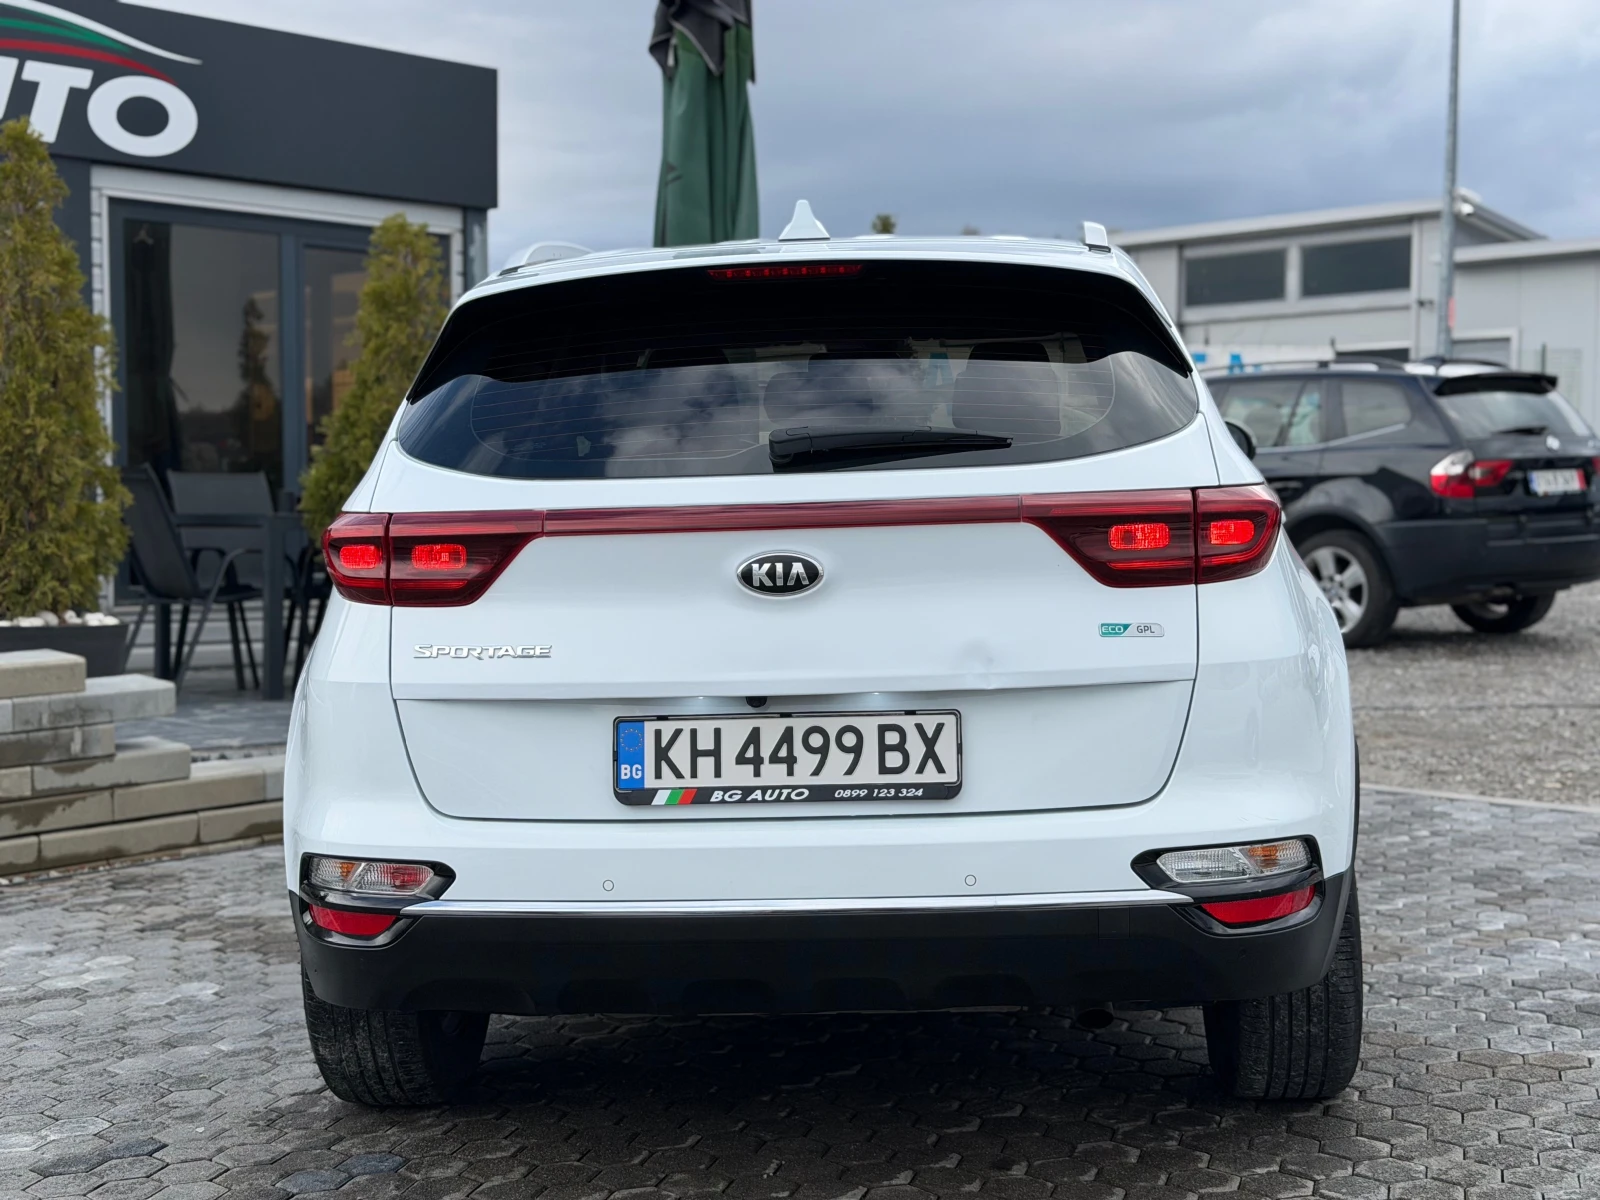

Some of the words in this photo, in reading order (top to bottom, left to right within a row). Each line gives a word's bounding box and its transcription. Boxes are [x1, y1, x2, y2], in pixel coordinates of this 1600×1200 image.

[0, 55, 198, 157] TO
[751, 562, 809, 587] KIA
[1101, 625, 1124, 633] ECO
[1136, 625, 1155, 633] GPL
[413, 644, 552, 660] SPORTAGE
[654, 727, 722, 780] KH
[735, 724, 864, 778] 4499
[877, 722, 947, 775] BX
[620, 764, 642, 780] BG
[710, 790, 743, 802] BG
[746, 788, 809, 801] AUTO
[834, 789, 868, 798] 0899
[872, 788, 895, 797] 123
[898, 788, 923, 797] 324
